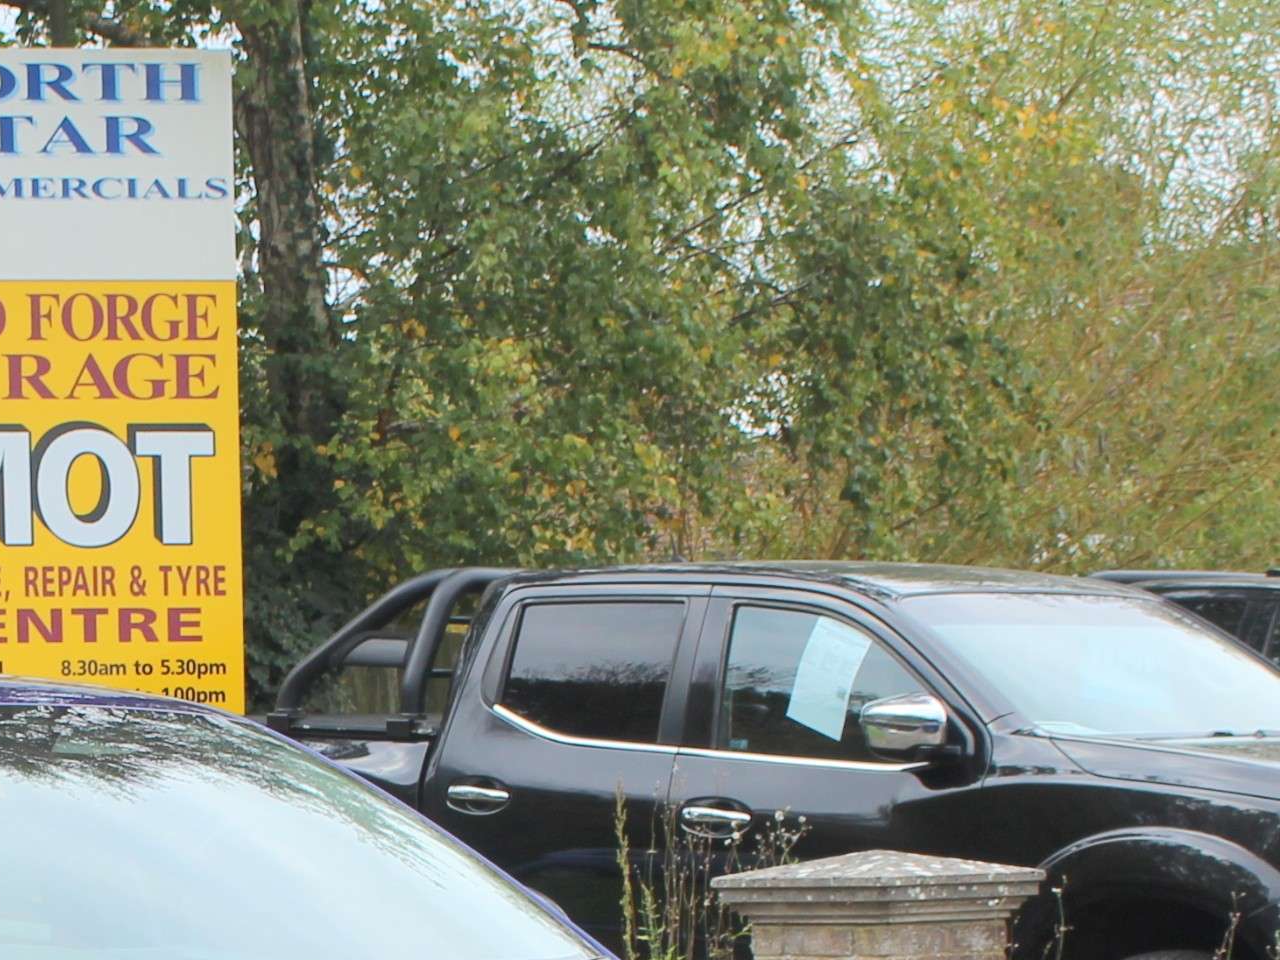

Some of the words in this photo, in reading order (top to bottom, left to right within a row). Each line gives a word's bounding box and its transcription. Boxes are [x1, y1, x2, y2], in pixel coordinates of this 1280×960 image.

[25, 292, 220, 342] FORGE
[24, 566, 117, 598] REPAIR
[129, 565, 147, 597] &
[159, 565, 227, 597] TYRE
[61, 660, 127, 676] 8.30am
[134, 660, 154, 676] to
[160, 659, 227, 679] 5.30pm
[161, 687, 226, 703] 100pm
